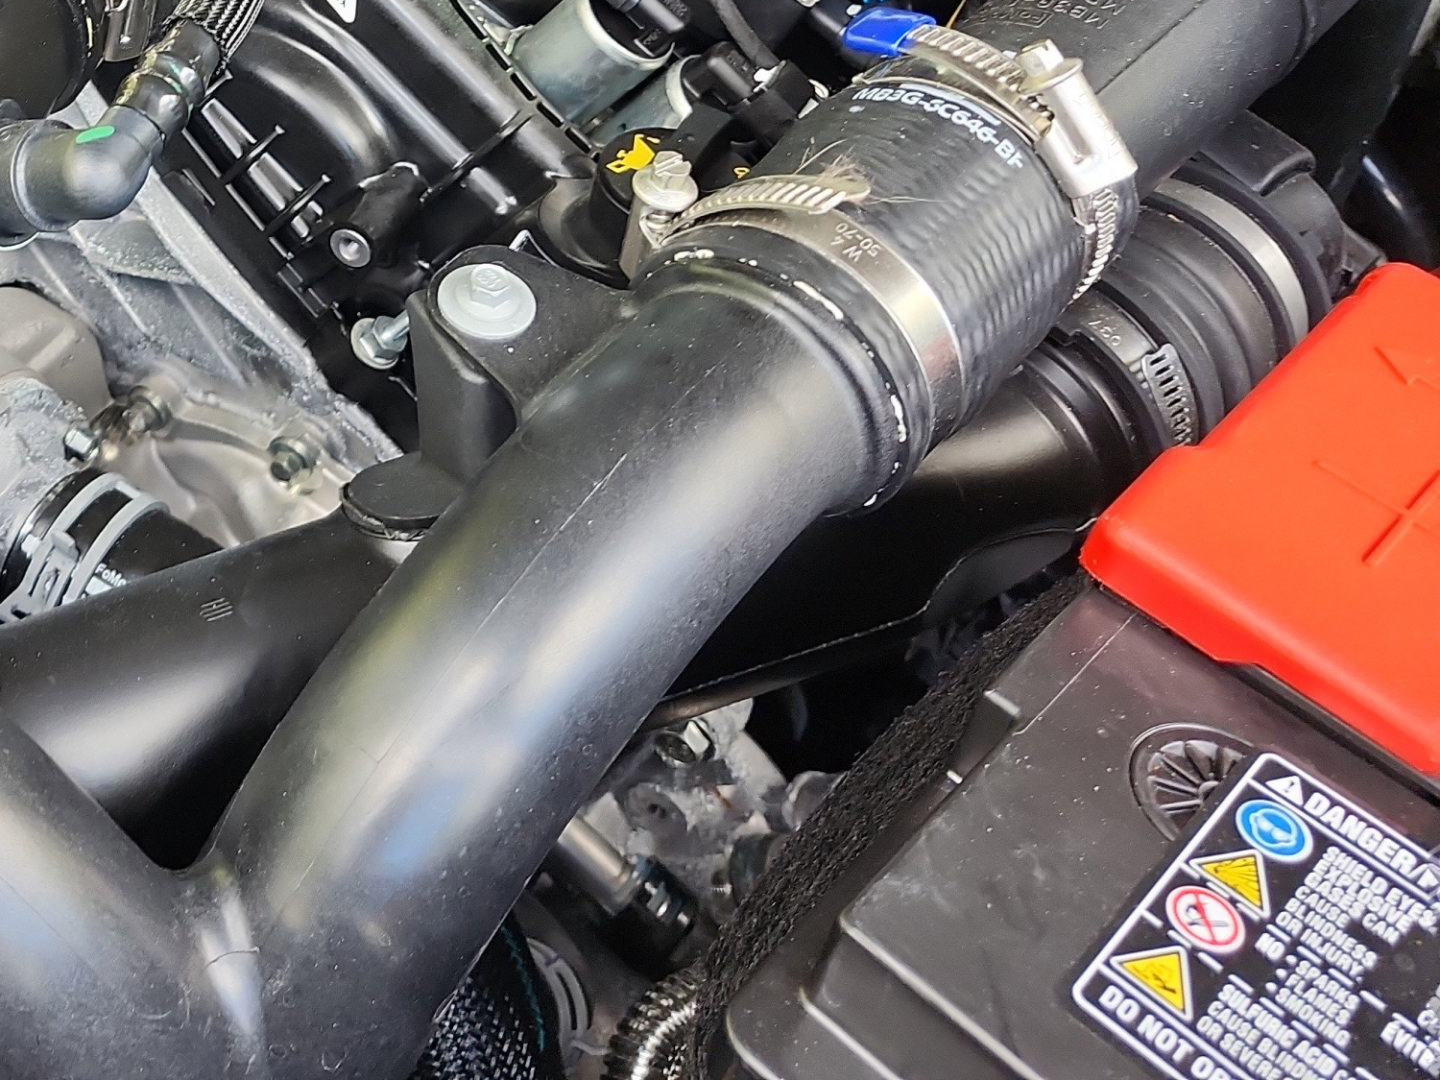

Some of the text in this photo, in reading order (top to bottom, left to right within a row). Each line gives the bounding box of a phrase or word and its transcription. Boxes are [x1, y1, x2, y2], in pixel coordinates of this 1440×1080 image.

[835, 223, 882, 257] 50-70
[1303, 792, 1417, 877] DANGER
[1322, 845, 1388, 895] SHIELD
[1295, 886, 1351, 929] CAUSE
[1304, 872, 1401, 947] GASES CAN
[1313, 859, 1413, 935] EXPLOSIVE
[1254, 932, 1286, 961] NO
[1275, 911, 1304, 938] OR
[1284, 897, 1378, 969] BLINDNESS
[1284, 973, 1351, 1025] FLAMES
[1295, 960, 1360, 1012] SPARKS
[1098, 985, 1141, 1023] DO
[1136, 1013, 1196, 1064] NOT
[1196, 1015, 1224, 1042] OR
[1208, 1001, 1262, 1047] CAUSE
[1218, 984, 1338, 1077] SULFURIC ACID
[1275, 987, 1352, 1049] SMOKING
